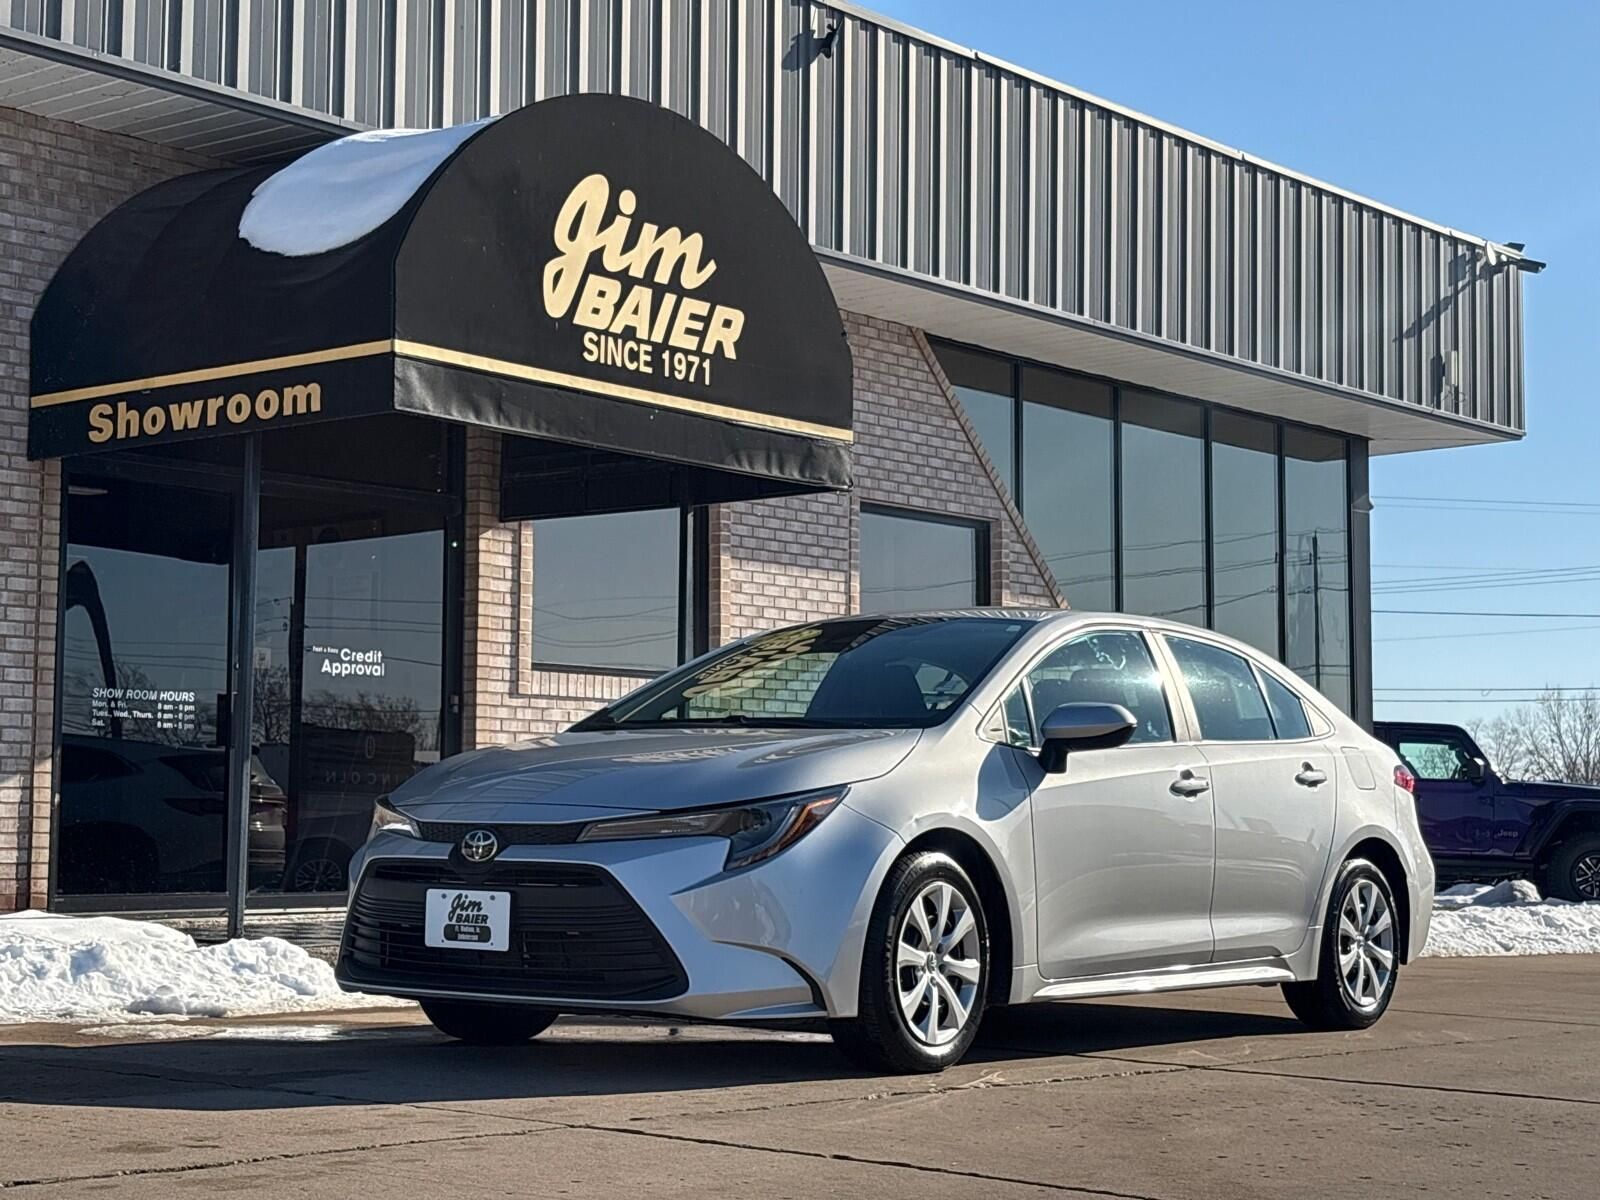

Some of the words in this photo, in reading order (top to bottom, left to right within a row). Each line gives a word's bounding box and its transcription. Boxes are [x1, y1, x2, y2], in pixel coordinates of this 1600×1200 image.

[543, 173, 717, 318] Jim
[572, 273, 745, 360] BAIER
[582, 331, 653, 374] SINCE
[662, 350, 711, 386] 1971
[88, 382, 321, 443] Showroom
[340, 648, 382, 663] Credit
[321, 658, 385, 677] Approval
[92, 688, 124, 698] SHOW
[126, 689, 158, 700] ROOM
[160, 691, 195, 702] HOURS
[184, 704, 195, 712] pm
[1497, 829, 1519, 838] Jeep
[448, 893, 483, 922] Jim
[455, 913, 489, 924] BAIER
